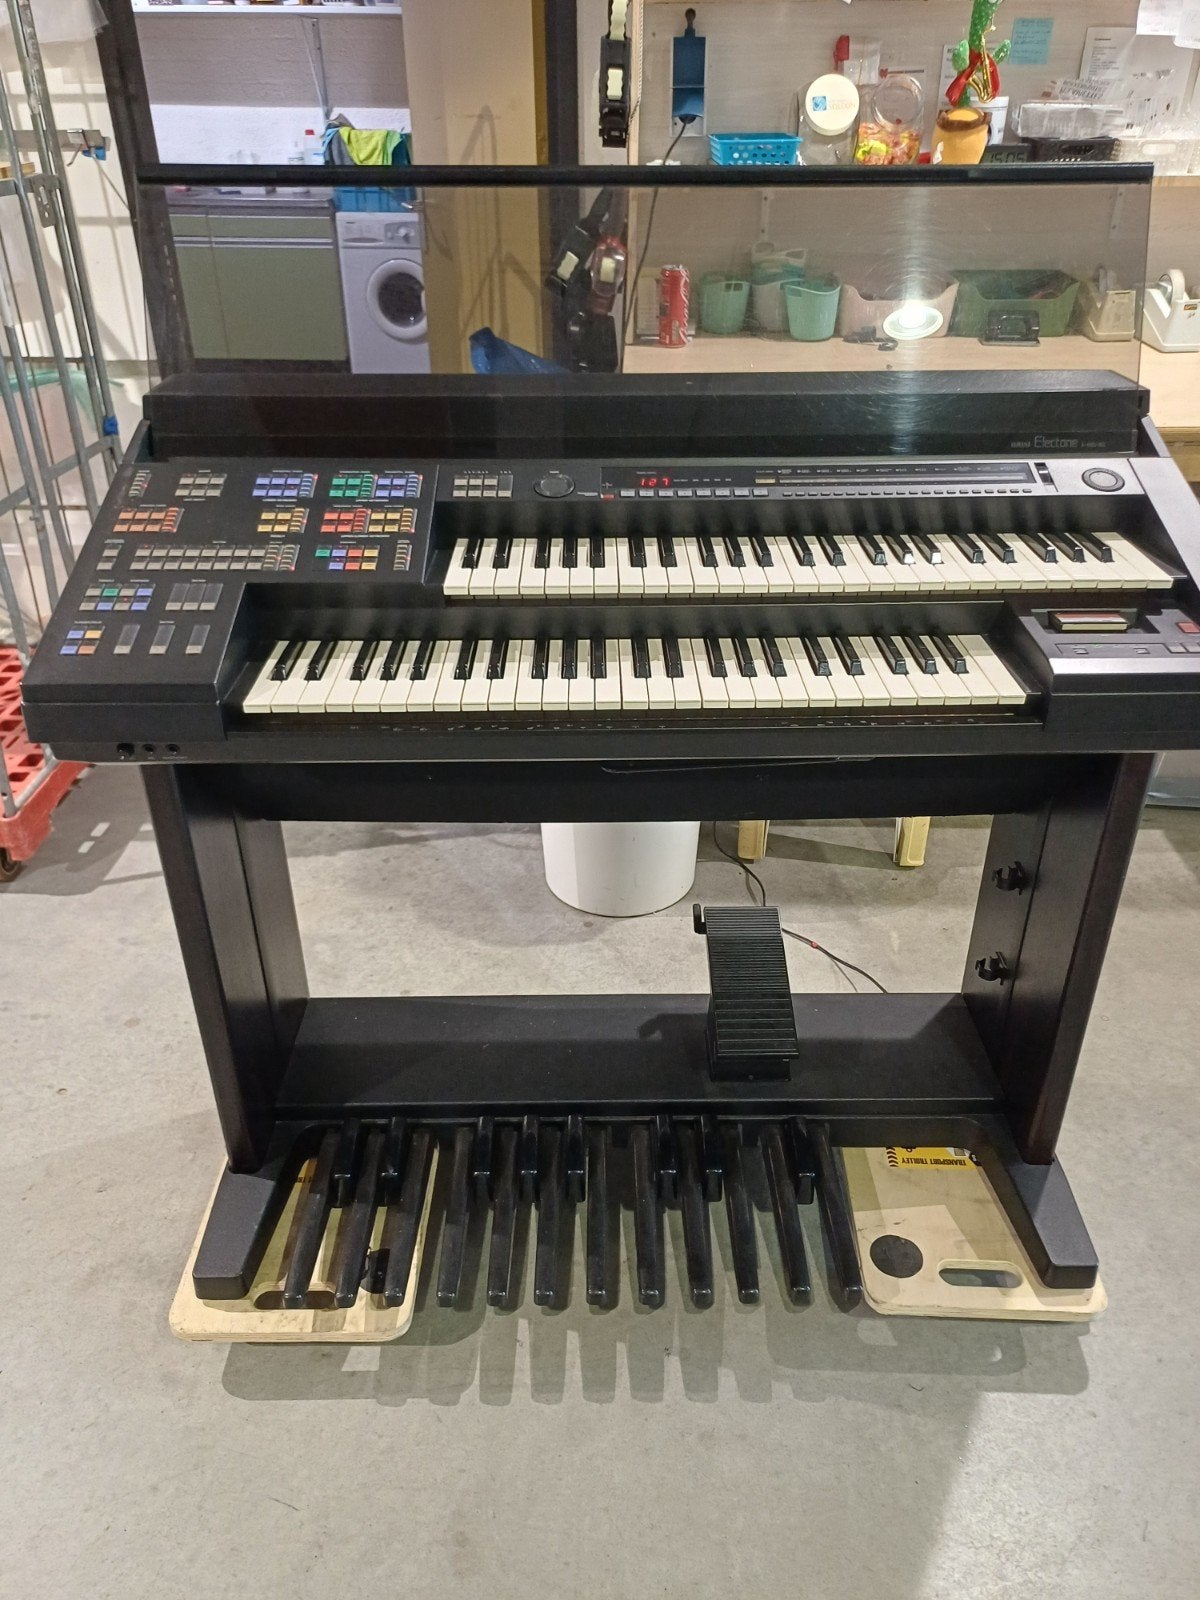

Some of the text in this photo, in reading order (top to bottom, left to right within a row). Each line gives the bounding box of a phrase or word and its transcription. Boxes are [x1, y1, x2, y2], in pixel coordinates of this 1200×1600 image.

[1034, 435, 1079, 448] Electone
[901, 1157, 967, 1166] TRANSPORT TROLLEY
